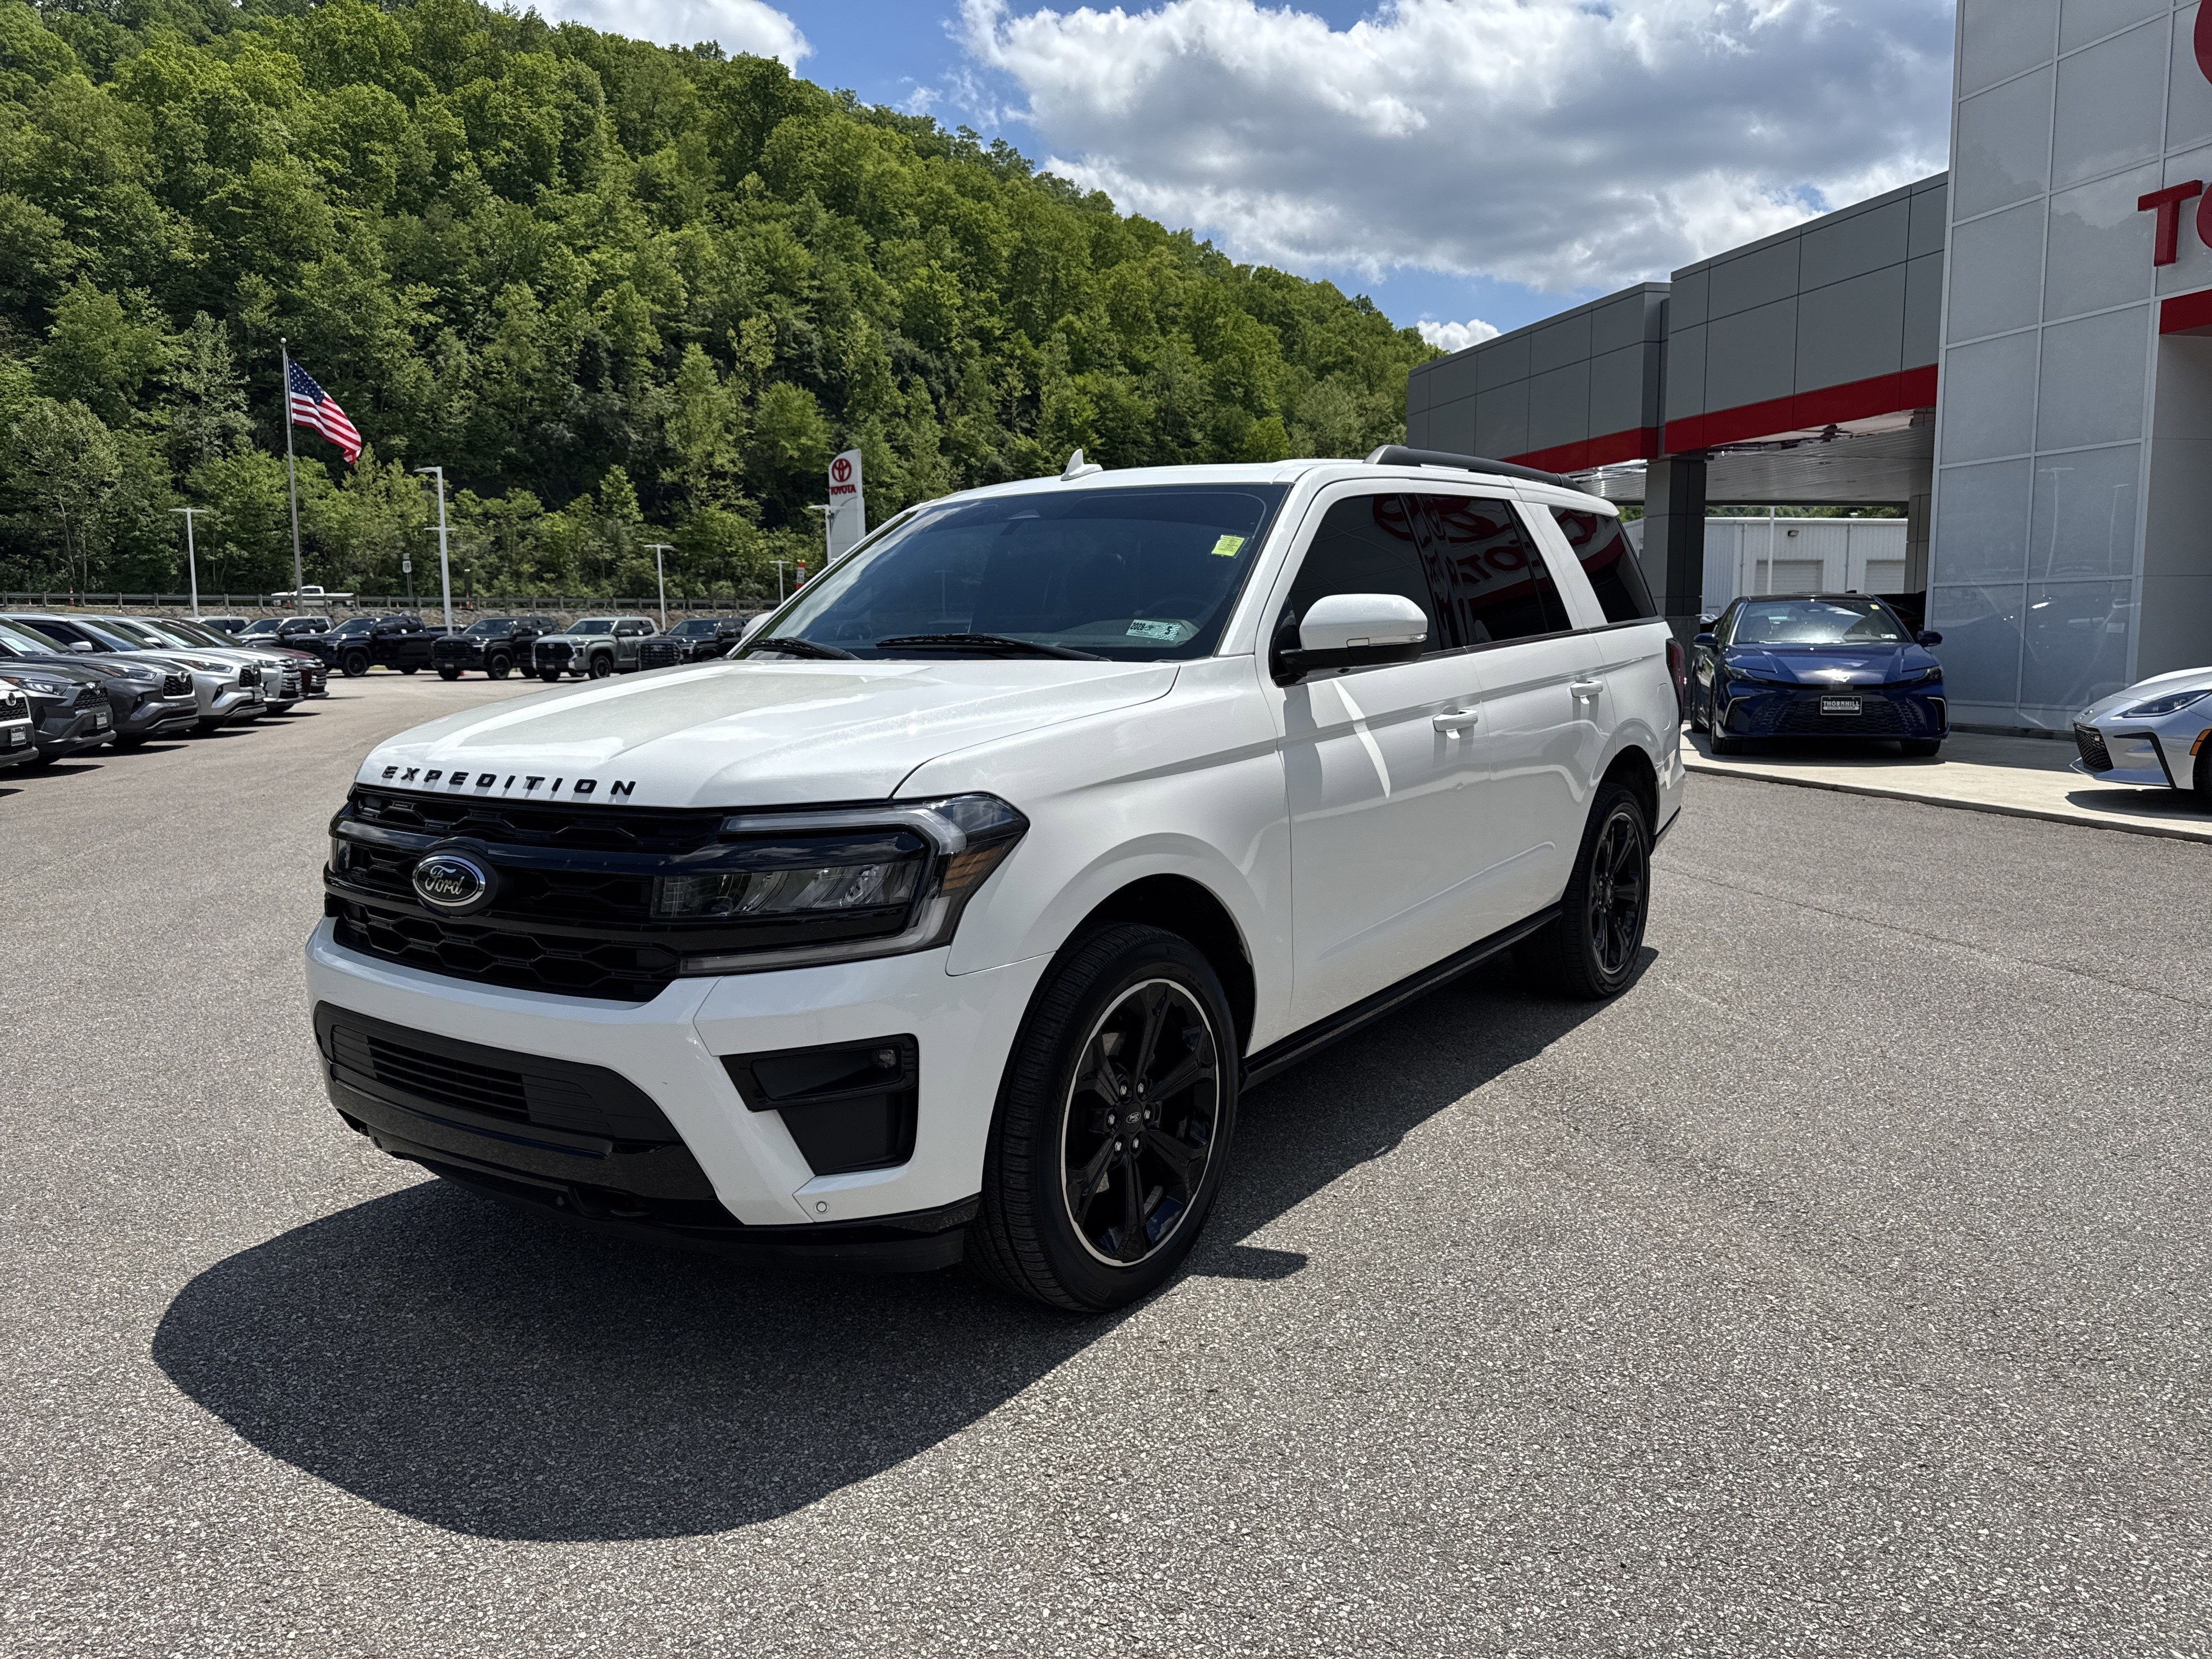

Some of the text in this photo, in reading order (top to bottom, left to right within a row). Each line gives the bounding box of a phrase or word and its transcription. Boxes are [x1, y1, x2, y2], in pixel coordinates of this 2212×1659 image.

[2138, 180, 2212, 267] T
[830, 484, 856, 495] TOYOTA
[1130, 622, 1173, 635] 2028 5
[382, 765, 636, 795] EXPEDITION
[425, 865, 465, 895] Ford
